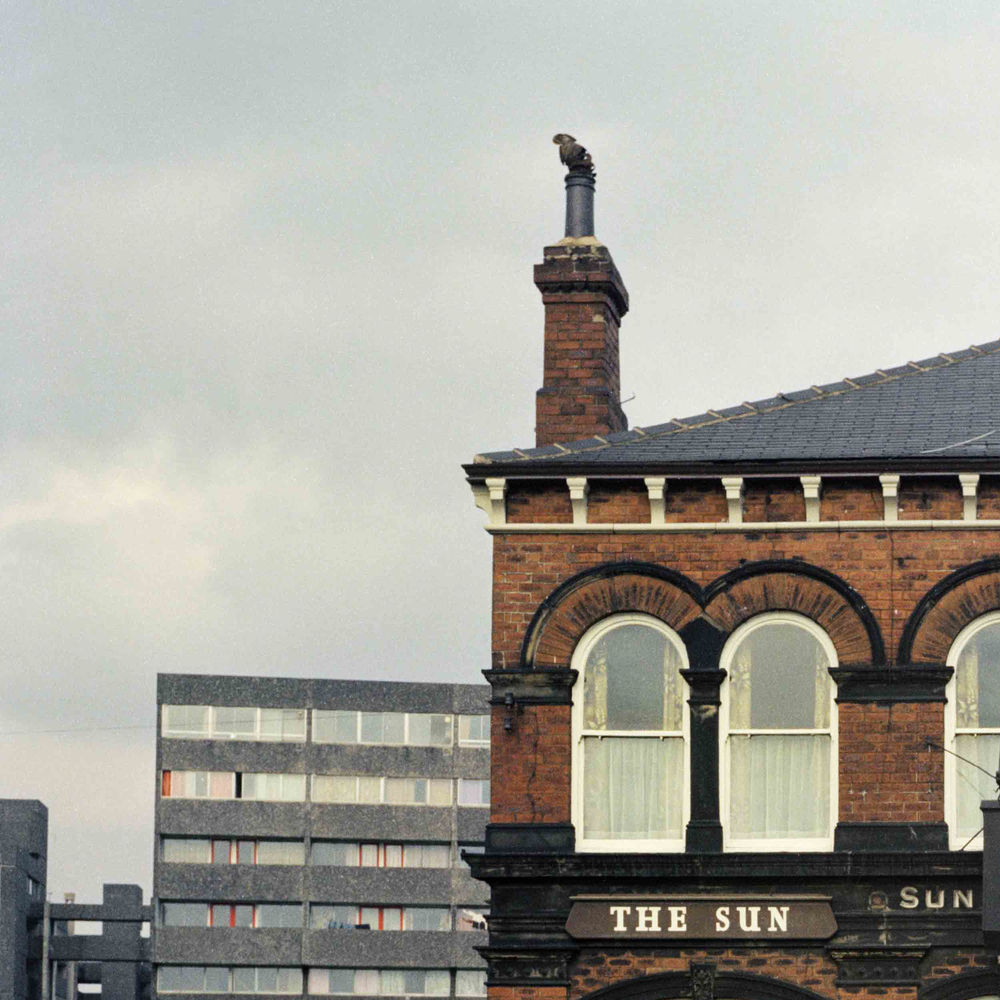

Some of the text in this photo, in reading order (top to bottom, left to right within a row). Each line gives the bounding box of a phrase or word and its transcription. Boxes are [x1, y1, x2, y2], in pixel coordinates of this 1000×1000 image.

[900, 886, 973, 909] SUN
[609, 906, 790, 932] THE SUN
